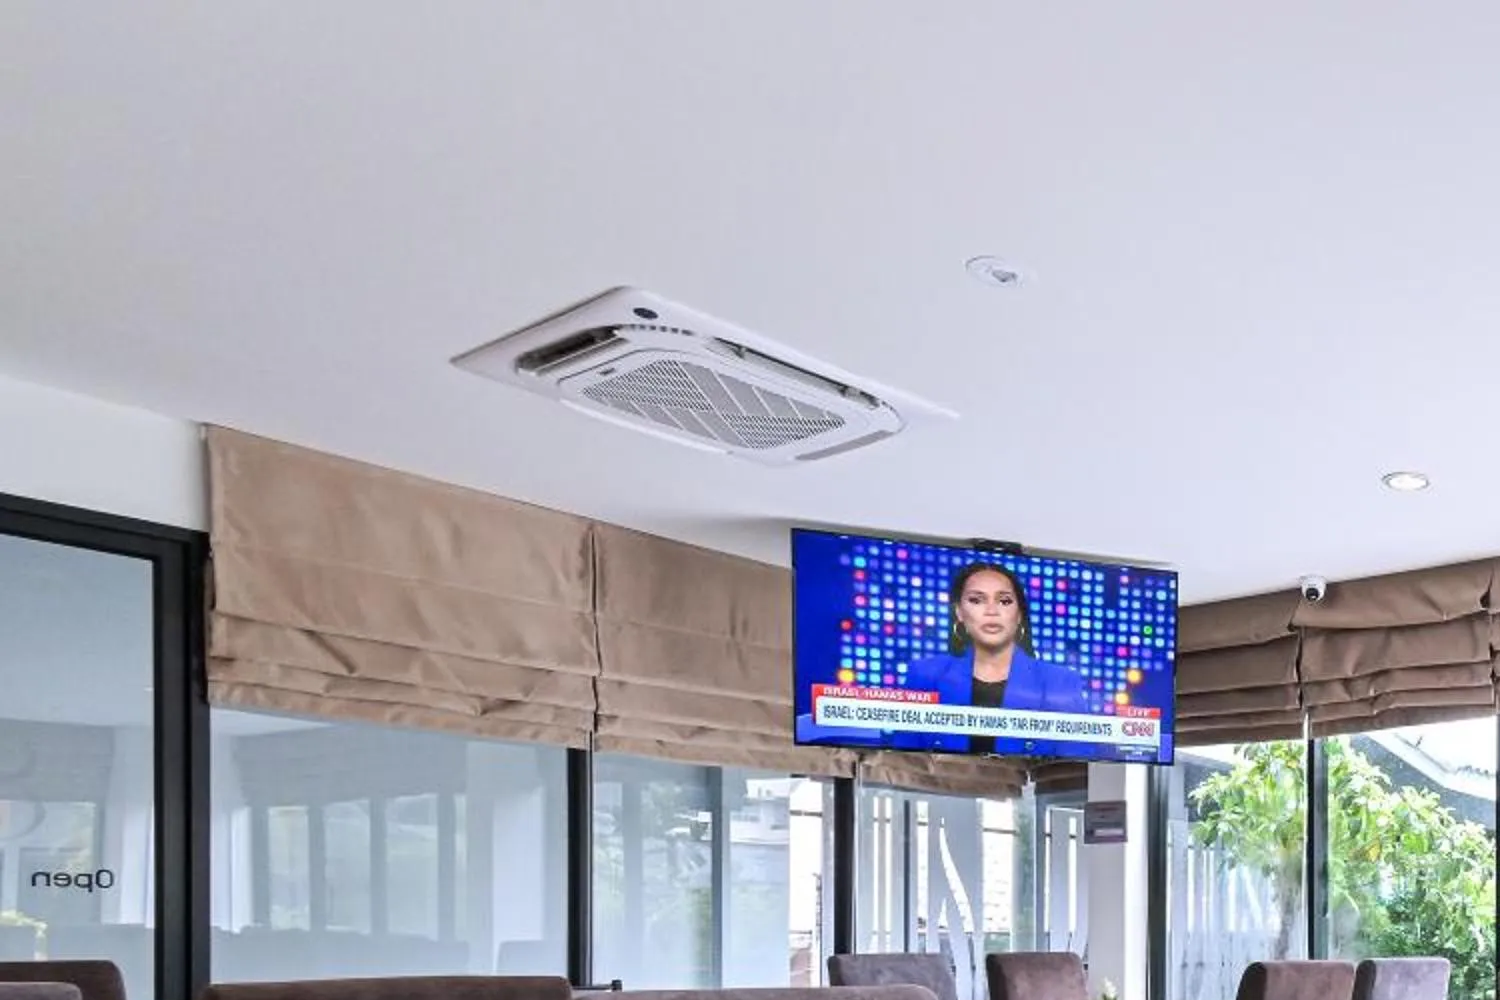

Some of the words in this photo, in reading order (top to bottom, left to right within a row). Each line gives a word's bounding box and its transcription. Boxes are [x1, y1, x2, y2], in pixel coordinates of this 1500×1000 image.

[823, 705, 854, 720] ISRAEL:
[855, 707, 900, 723] CEASEFIRE
[901, 709, 923, 725] DEAL
[924, 711, 965, 727] ACCEPTED
[967, 713, 977, 728] BY
[979, 715, 1007, 730] HAMAS
[1055, 720, 1113, 736] REQUIREMENTS
[1121, 721, 1155, 737] CNN
